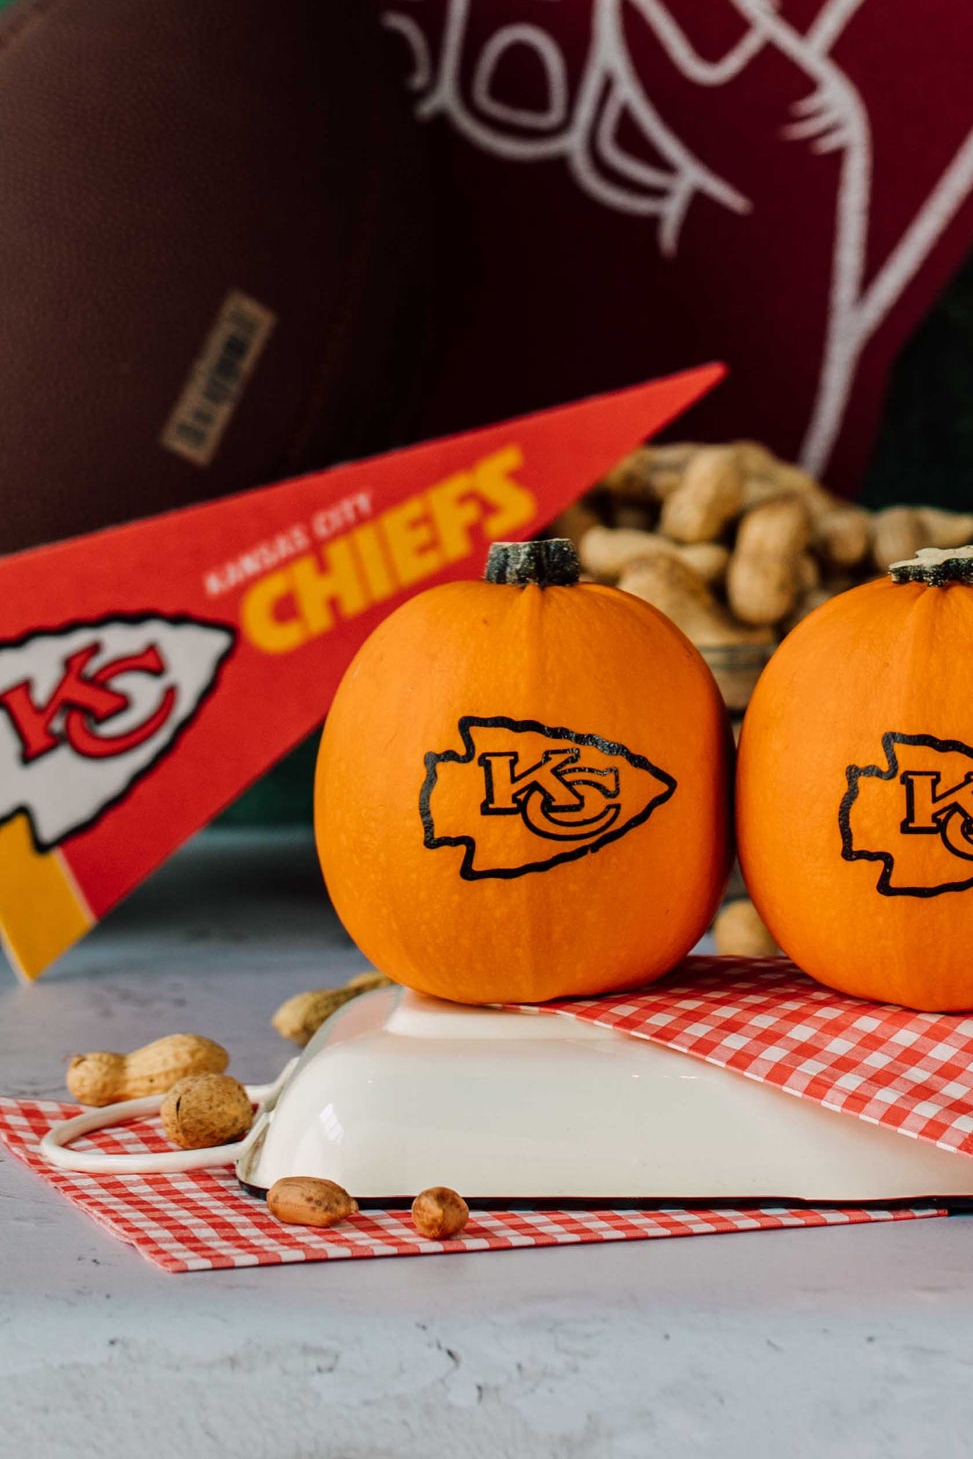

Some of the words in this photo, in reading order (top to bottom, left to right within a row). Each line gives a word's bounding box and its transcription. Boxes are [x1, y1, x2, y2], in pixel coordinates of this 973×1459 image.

[205, 522, 308, 595] KANSAS
[312, 490, 372, 538] CITY
[242, 444, 537, 655] CHIEFS
[0, 639, 177, 764] KC
[478, 748, 621, 840] KC
